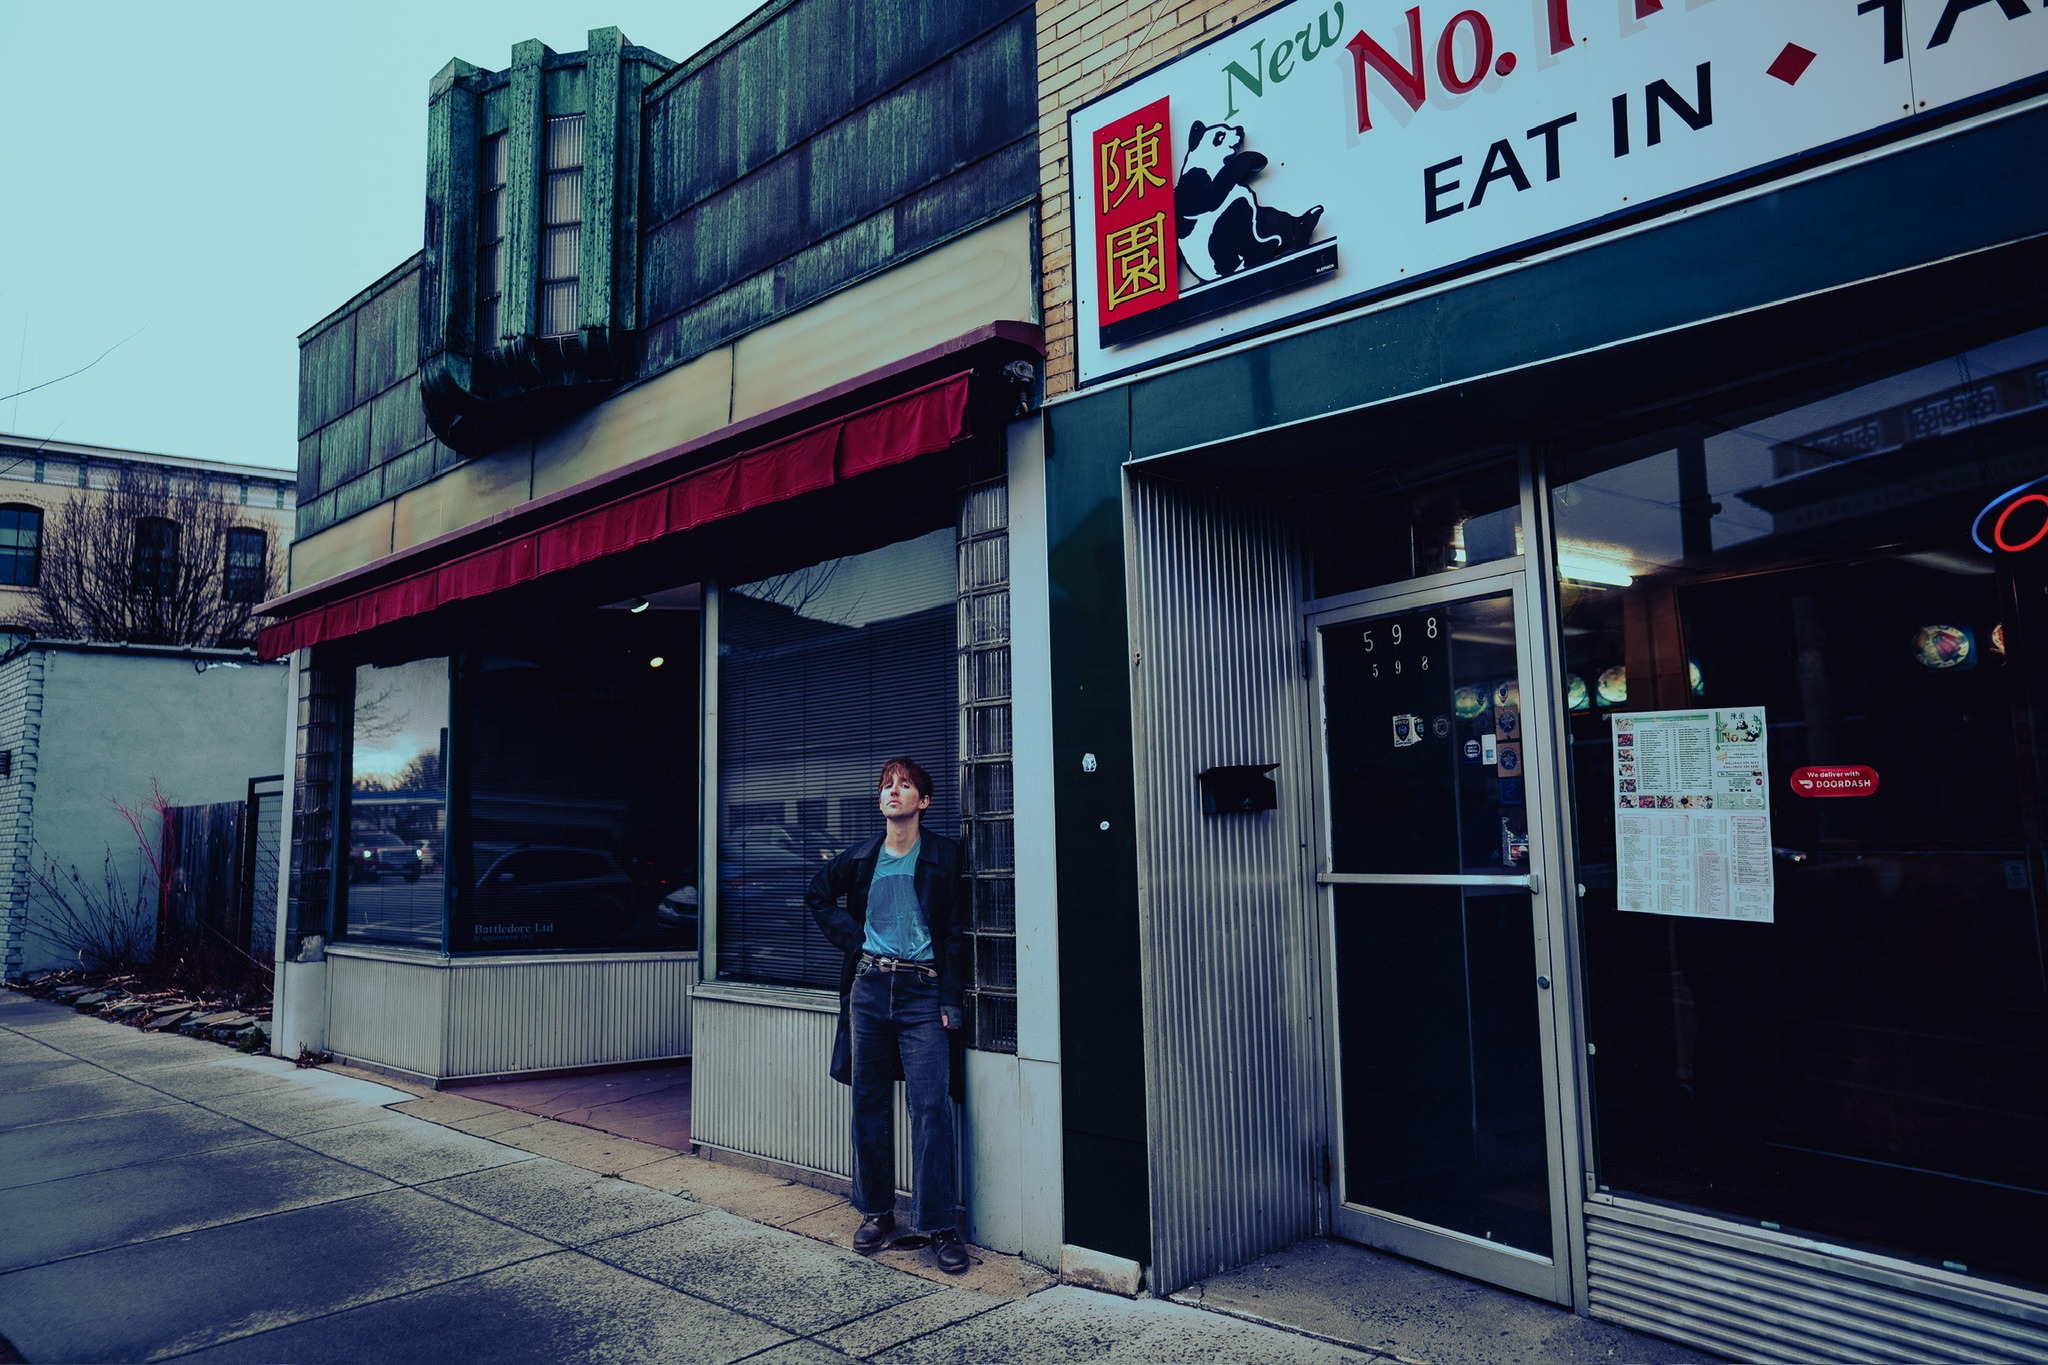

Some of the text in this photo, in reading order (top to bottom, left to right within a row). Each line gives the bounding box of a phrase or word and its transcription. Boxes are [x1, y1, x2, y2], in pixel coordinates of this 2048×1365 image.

[1222, 1, 1344, 121] New
[1345, 5, 1517, 134] No.
[1424, 0, 2048, 224] EAT IN TA
[1101, 121, 1167, 310] 陳園
[1816, 779, 1871, 788] DOORDASH
[475, 922, 554, 934] Battledore Ltd
